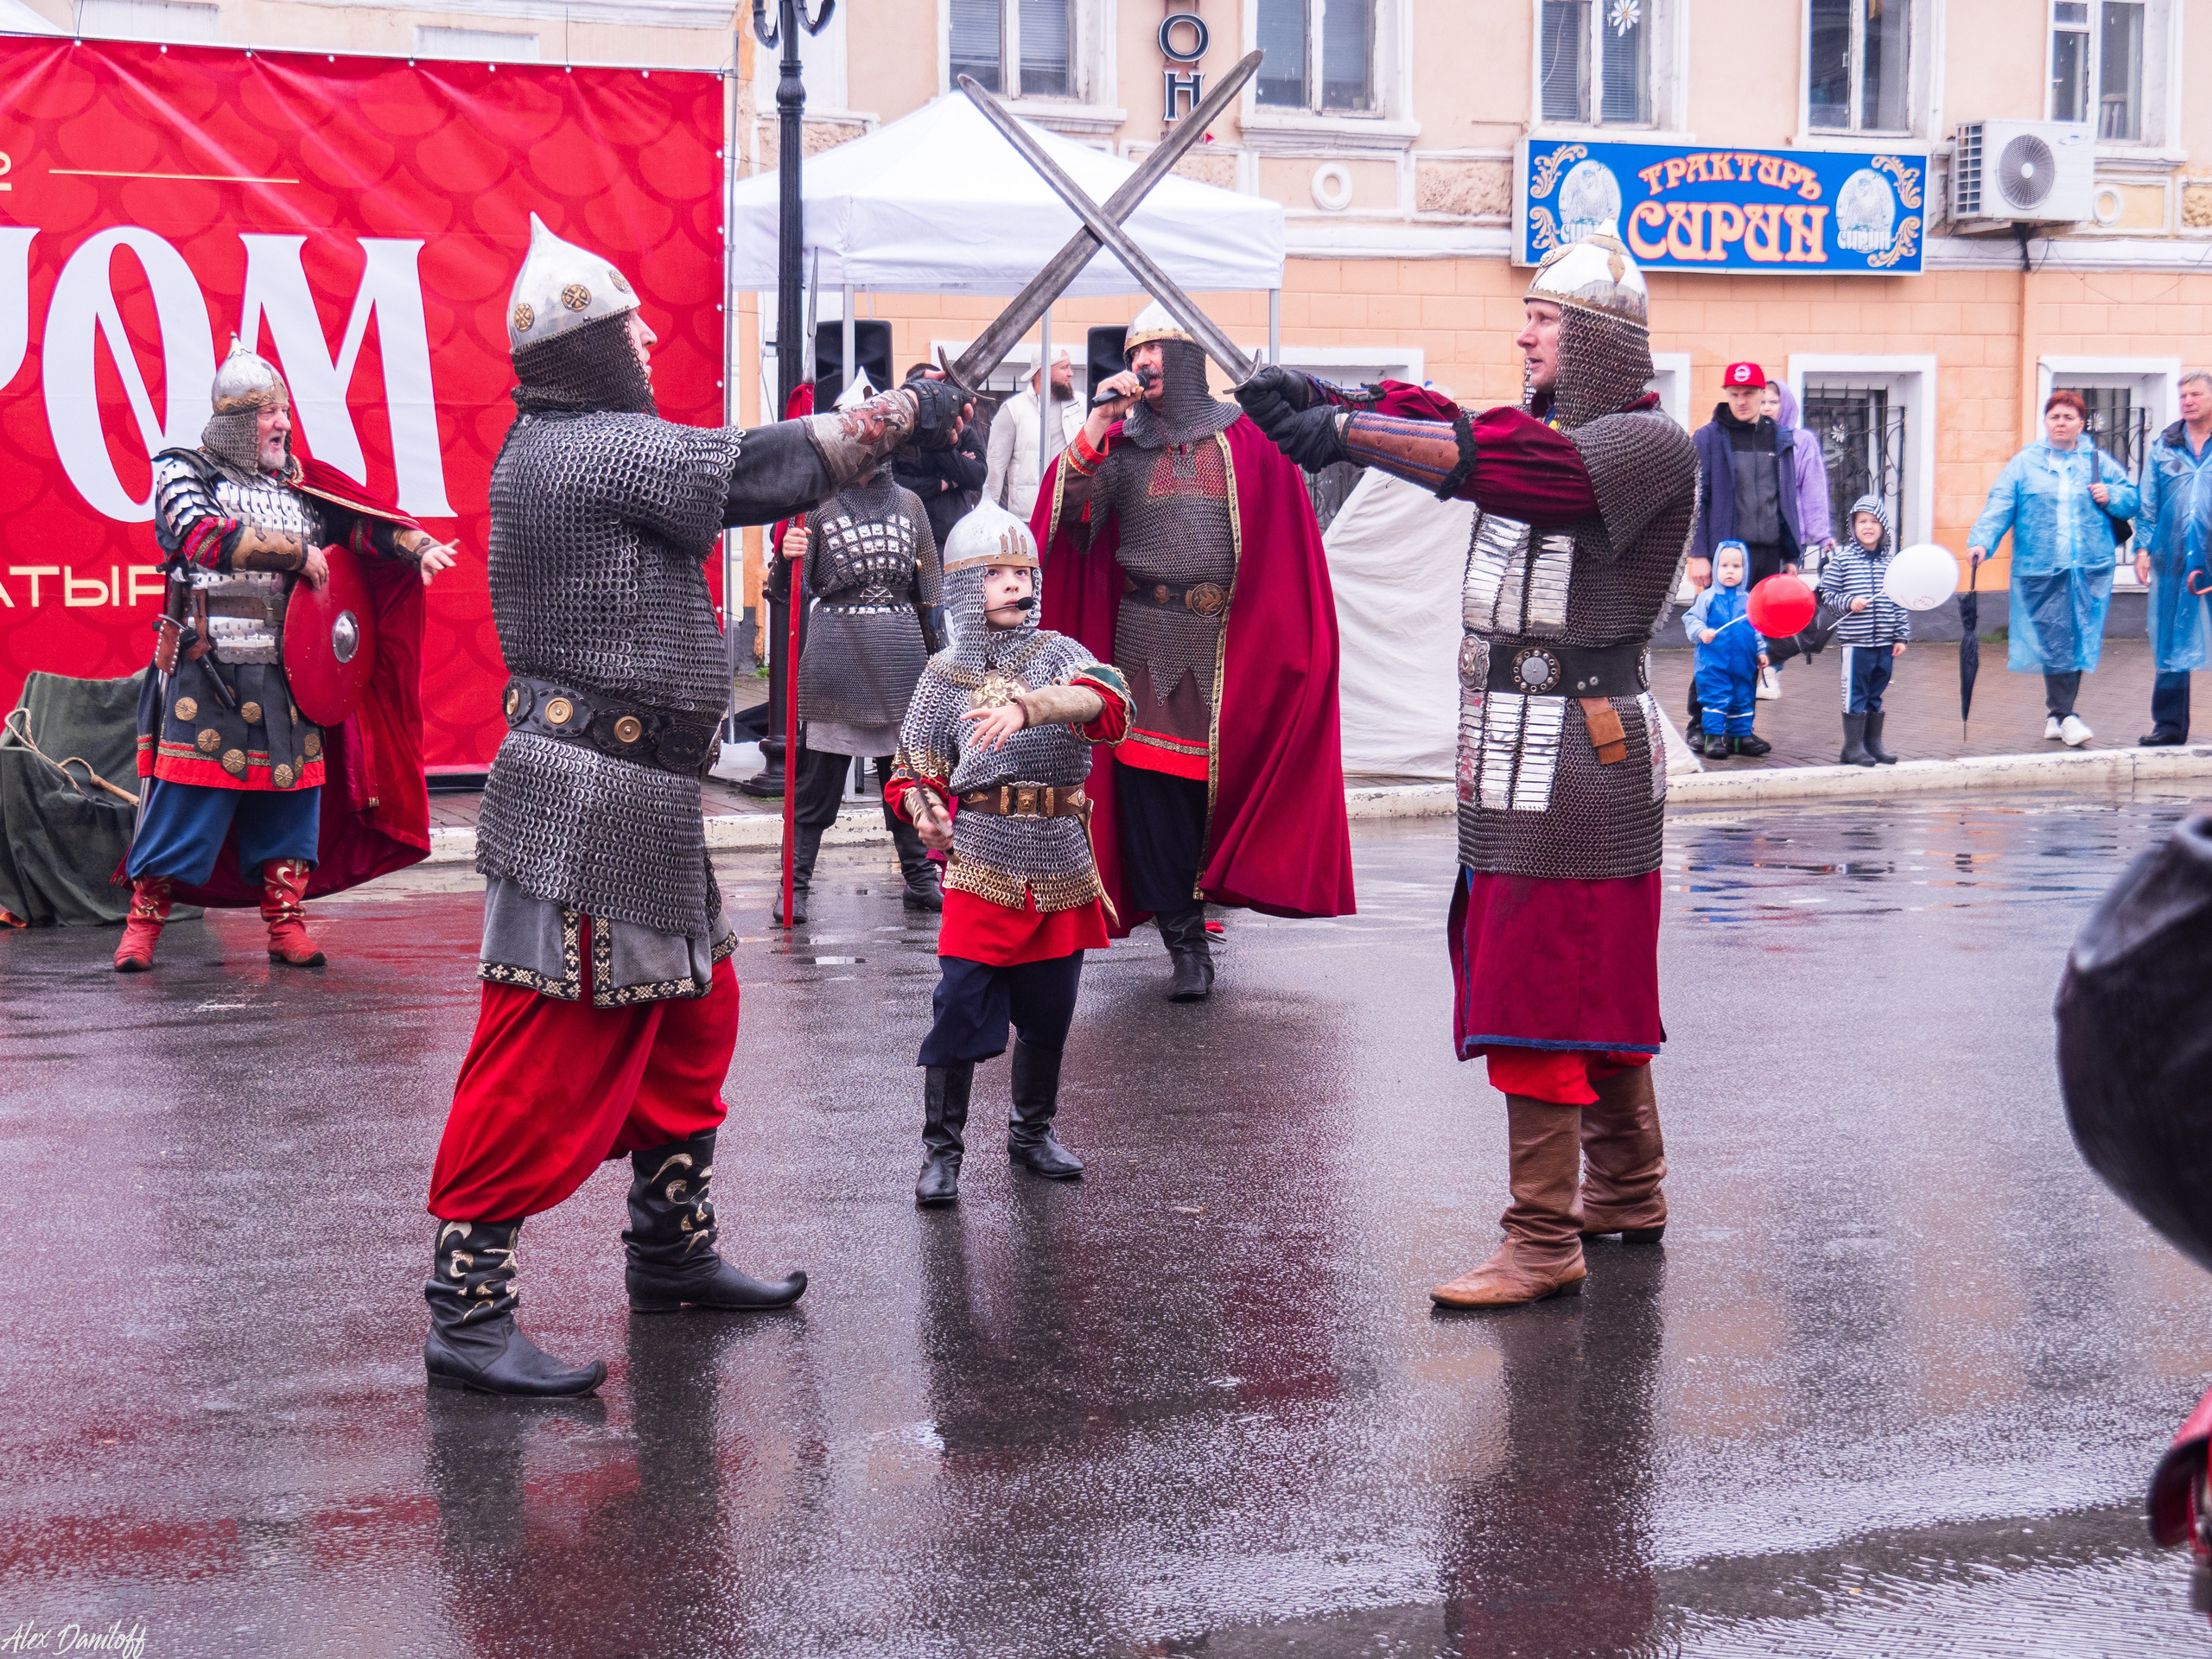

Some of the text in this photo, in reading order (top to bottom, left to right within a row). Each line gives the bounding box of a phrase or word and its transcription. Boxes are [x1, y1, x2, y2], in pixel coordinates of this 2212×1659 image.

[1627, 200, 1830, 263] СИРИН
[1837, 230, 1891, 251] СИРИН
[0, 225, 459, 524] ОМ
